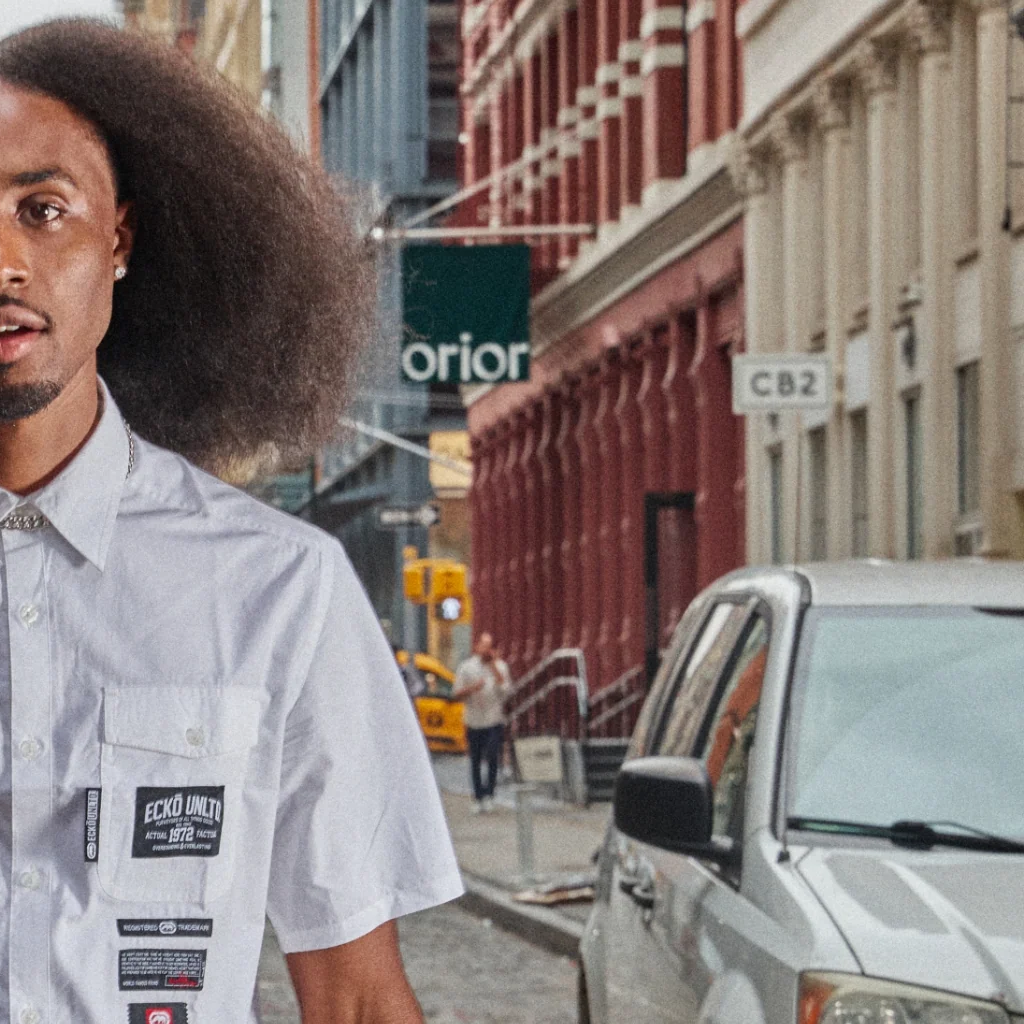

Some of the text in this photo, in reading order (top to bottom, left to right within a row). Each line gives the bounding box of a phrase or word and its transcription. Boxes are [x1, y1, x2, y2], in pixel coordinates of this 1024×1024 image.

[402, 332, 528, 382] orior
[750, 371, 818, 396] CB2
[144, 793, 183, 824] ECKŌ
[168, 827, 195, 843] 1972
